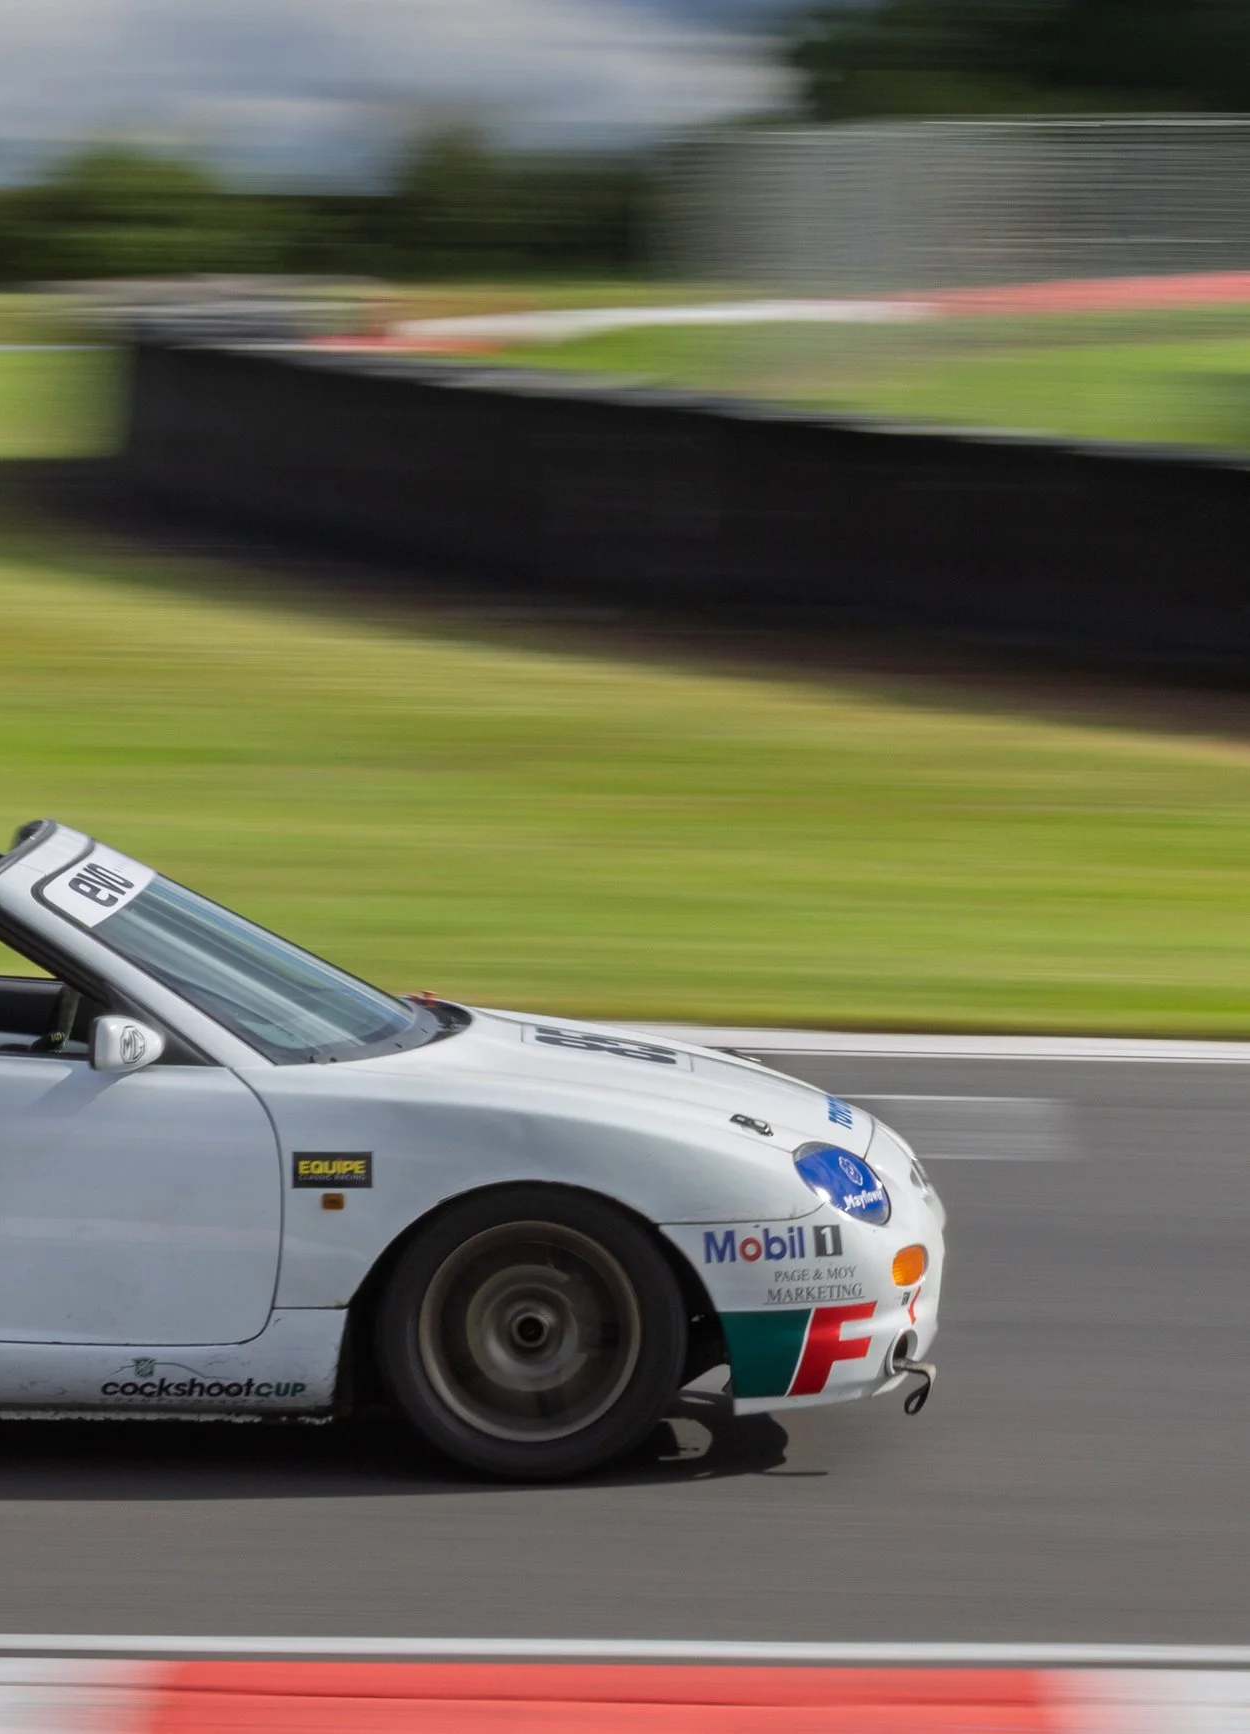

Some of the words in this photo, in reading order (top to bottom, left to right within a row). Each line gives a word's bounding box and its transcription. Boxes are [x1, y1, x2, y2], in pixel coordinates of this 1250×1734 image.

[68, 863, 135, 907] evo
[298, 1160, 367, 1175] EQUIPE
[703, 1226, 806, 1264] Mobil
[817, 1225, 839, 1257] 1
[774, 1269, 810, 1283] PAGE
[813, 1267, 824, 1280] &
[827, 1265, 858, 1280] MOY
[766, 1283, 864, 1302] MARKETING
